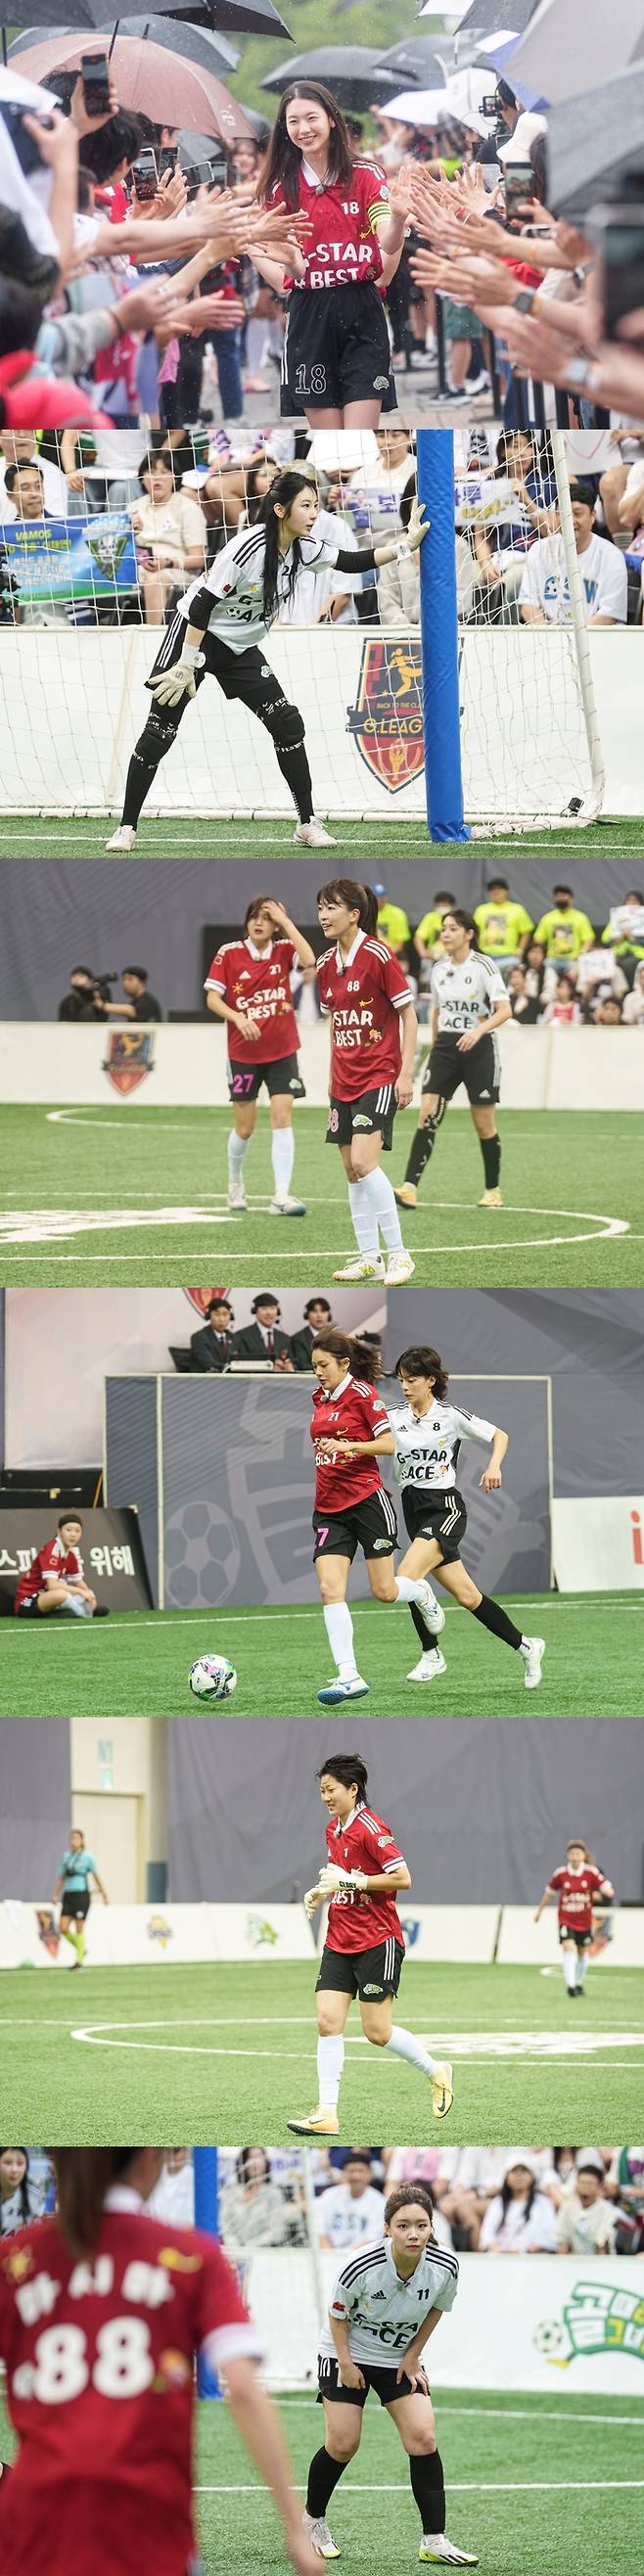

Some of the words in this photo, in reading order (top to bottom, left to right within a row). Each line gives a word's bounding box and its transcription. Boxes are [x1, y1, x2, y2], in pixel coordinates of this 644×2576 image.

[342, 202, 360, 215] 18
[304, 243, 373, 268] -STAR
[310, 268, 359, 290] BEST
[296, 363, 327, 394] 18
[268, 964, 282, 976] 27
[346, 980, 360, 992] 88
[236, 987, 286, 1010] G-STAR
[246, 1002, 277, 1021] BEST
[444, 1017, 474, 1029] ACE
[335, 1029, 362, 1047] BEST
[233, 1075, 254, 1093] 27
[328, 1411, 340, 1422] 27
[433, 1422, 441, 1432] 8
[396, 1449, 447, 1464] G-STAR
[407, 1465, 435, 1480] ACE
[315, 1528, 329, 1547] 7
[90, 1544, 135, 1576] 위해
[416, 2288, 430, 2300] 11
[34, 2315, 155, 2406] 88
